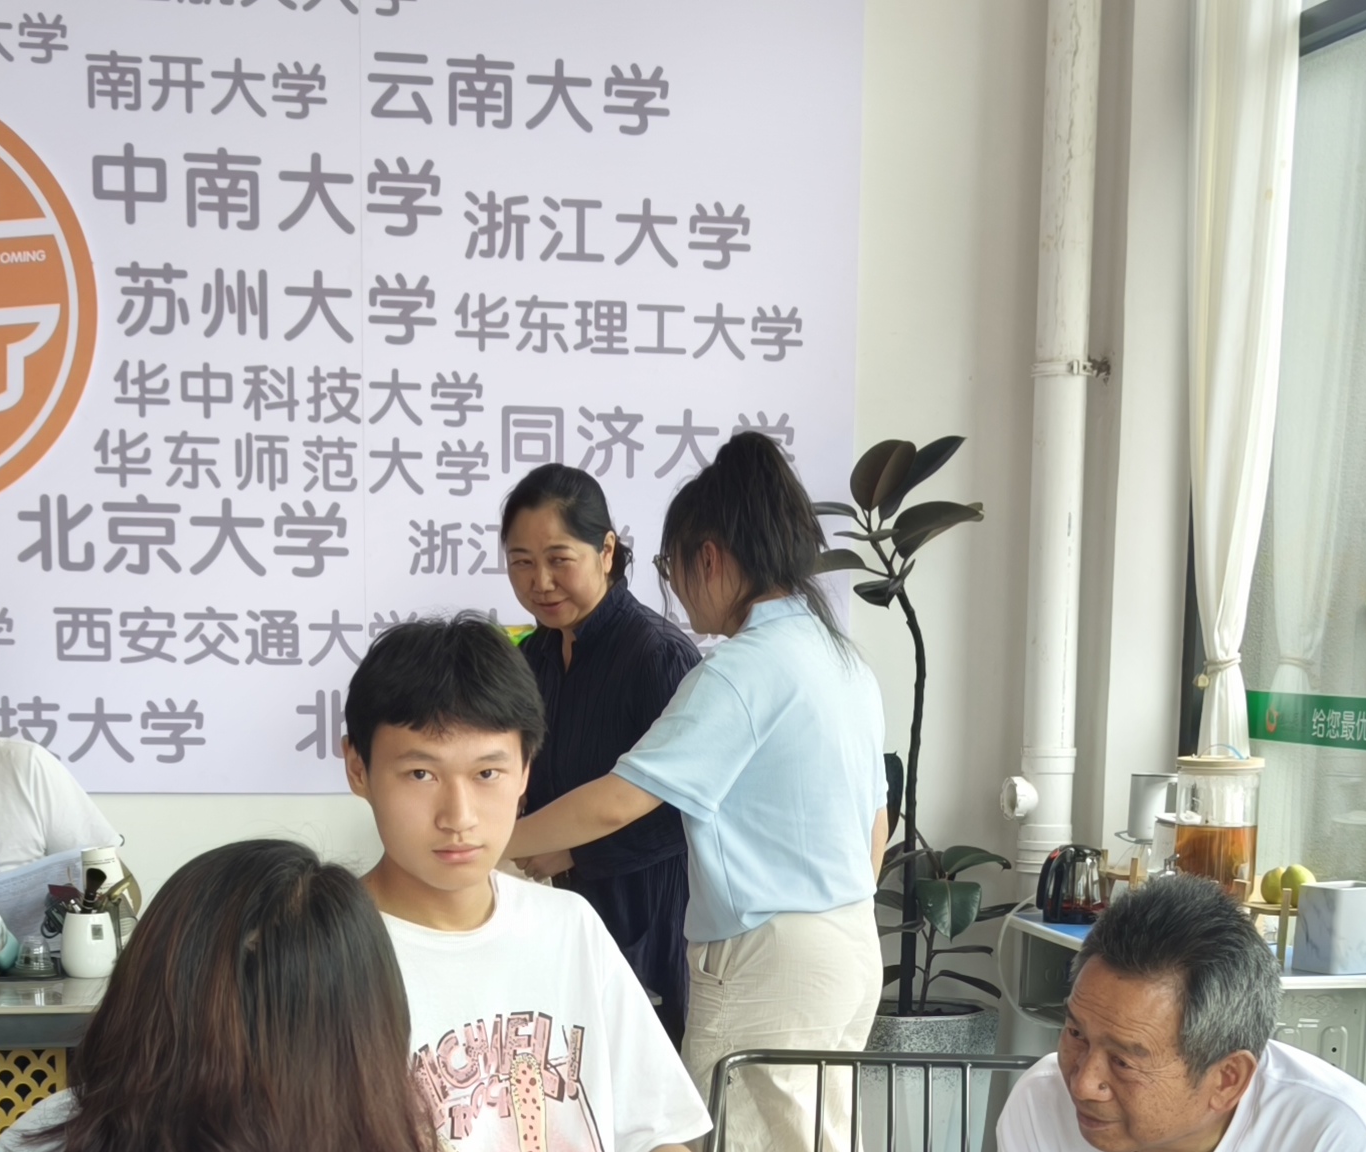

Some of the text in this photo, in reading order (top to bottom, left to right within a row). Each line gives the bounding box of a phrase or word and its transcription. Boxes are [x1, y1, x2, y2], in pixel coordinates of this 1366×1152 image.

[85, 50, 328, 120] 南开大学
[367, 51, 671, 136] 云南大学
[92, 142, 443, 237] 中南大学
[464, 191, 752, 271] 浙江大学
[115, 261, 438, 346] 苏州大学
[455, 293, 804, 362] 华东理工大学
[113, 359, 484, 427] 华中科技大学
[93, 429, 491, 497] 华东师范大学
[17, 493, 349, 578] 北京大学
